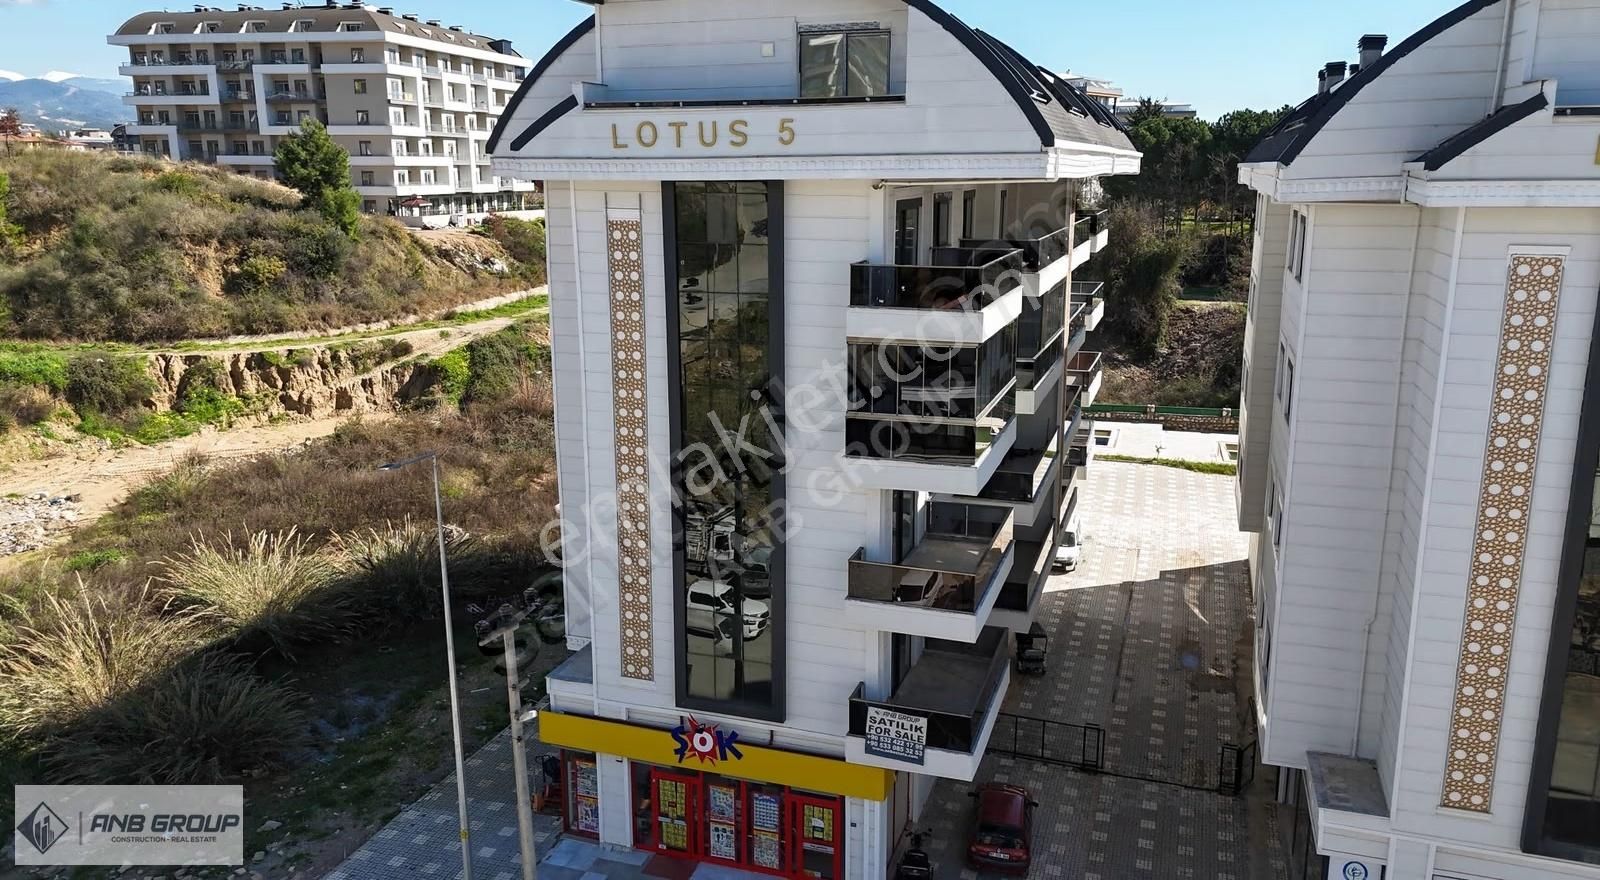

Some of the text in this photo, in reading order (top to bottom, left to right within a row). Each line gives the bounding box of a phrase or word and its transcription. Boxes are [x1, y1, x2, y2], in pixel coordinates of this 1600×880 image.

[611, 118, 795, 149] LOTUS 5
[869, 716, 924, 734] SATILIK
[898, 713, 920, 723] GROUP
[868, 725, 924, 743] FOR SALE
[671, 725, 743, 763] ŞOK
